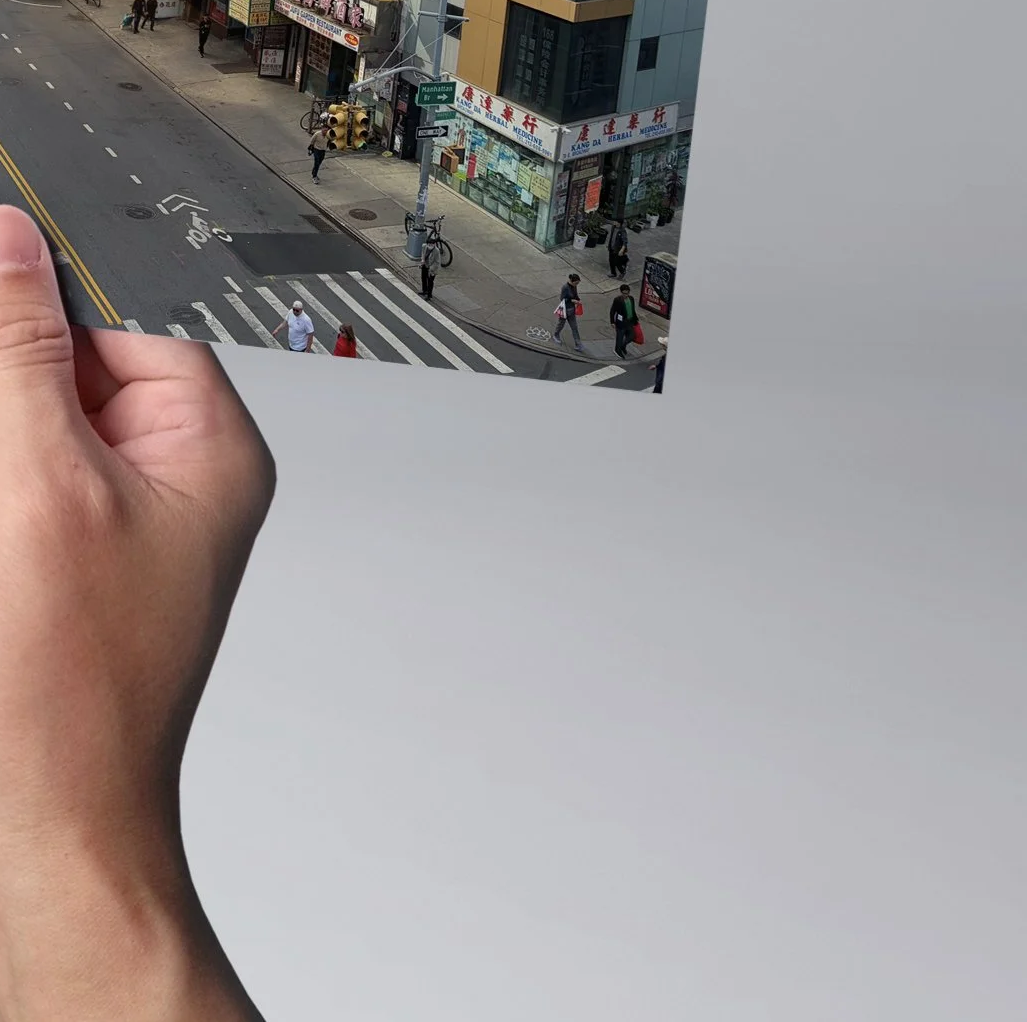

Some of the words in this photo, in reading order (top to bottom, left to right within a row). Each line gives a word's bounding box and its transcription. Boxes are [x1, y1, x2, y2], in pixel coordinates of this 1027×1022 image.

[316, 17, 342, 37] RESTAURANT
[456, 96, 472, 109] KANG
[473, 104, 481, 115] DA
[485, 112, 509, 129] HERBAL
[512, 125, 543, 147] MEDICINE
[571, 141, 590, 152] KANG
[592, 139, 601, 147] DA
[608, 131, 633, 143] HERBAL
[639, 121, 668, 135] MEDICINE
